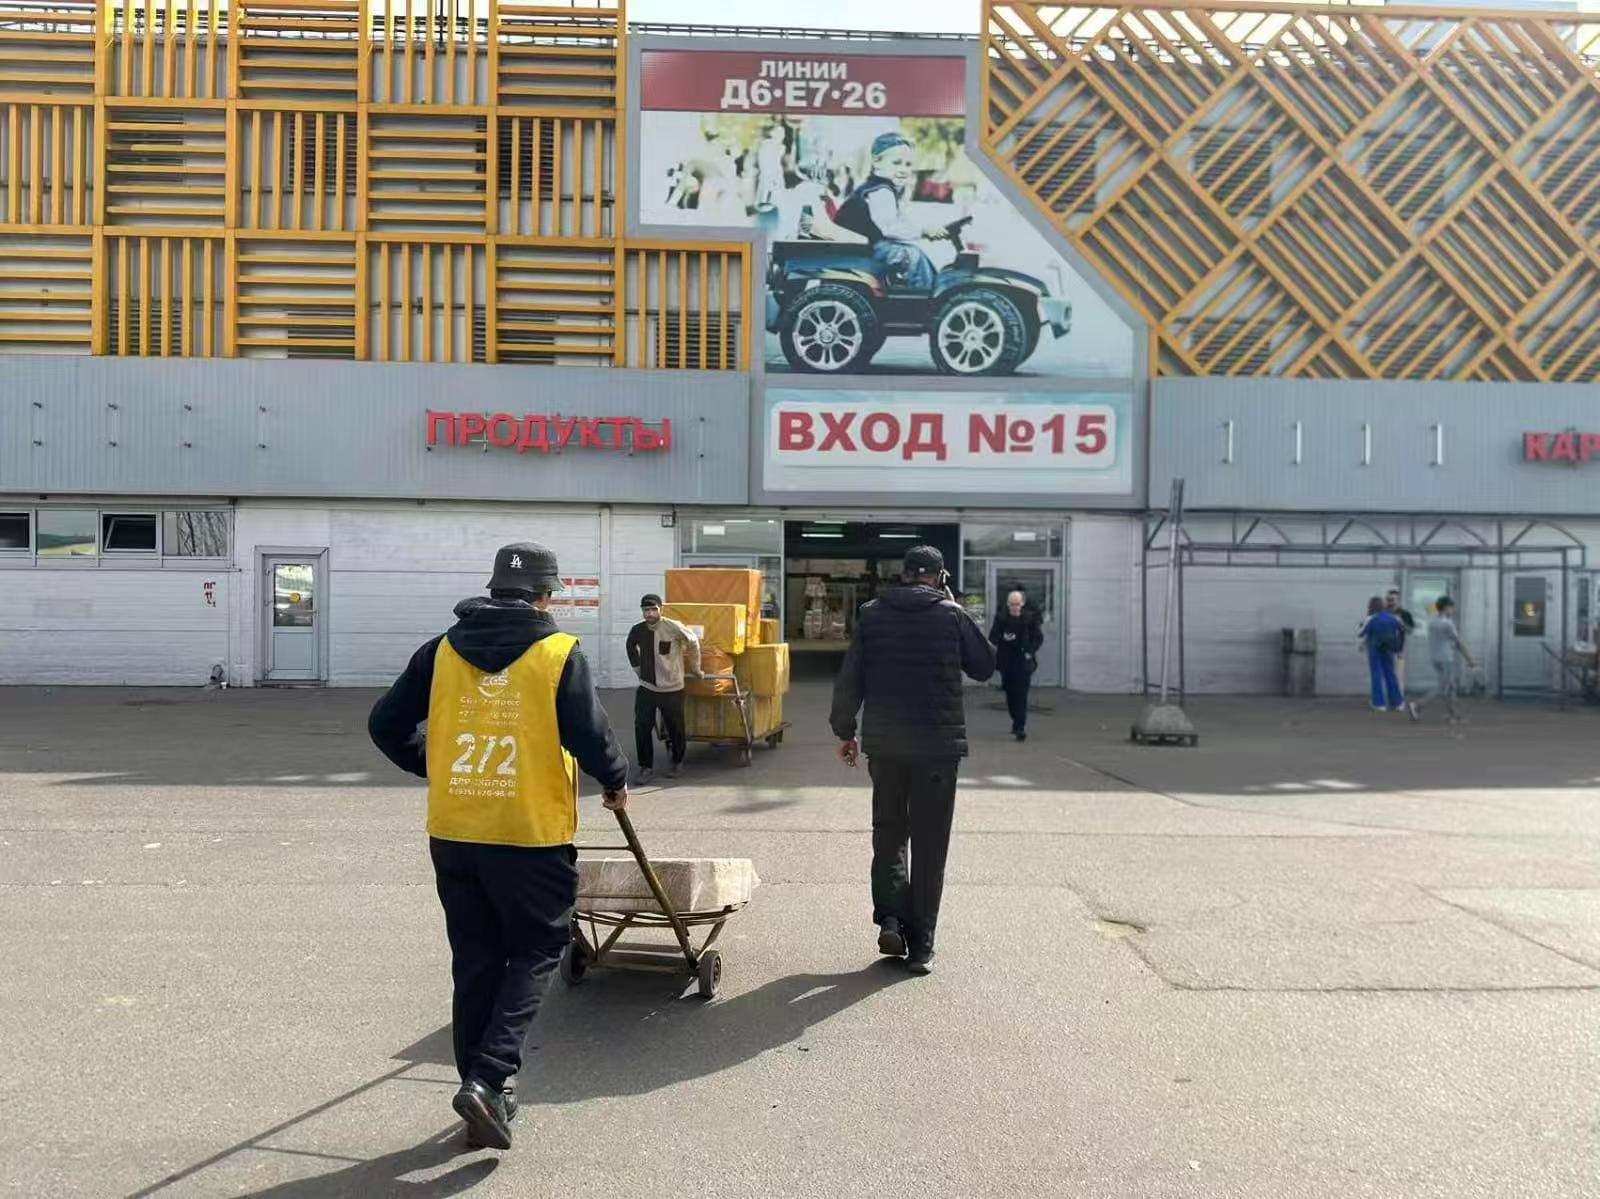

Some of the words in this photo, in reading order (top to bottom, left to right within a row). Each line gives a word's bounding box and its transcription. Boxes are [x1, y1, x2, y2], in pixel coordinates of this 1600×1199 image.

[759, 60, 847, 80] ЛИНИИ
[426, 410, 671, 455] ПРОДУКТЫ
[778, 411, 947, 461] ВХОД
[968, 413, 1107, 455] №15
[509, 554, 522, 569] LA
[451, 732, 517, 776] 272
